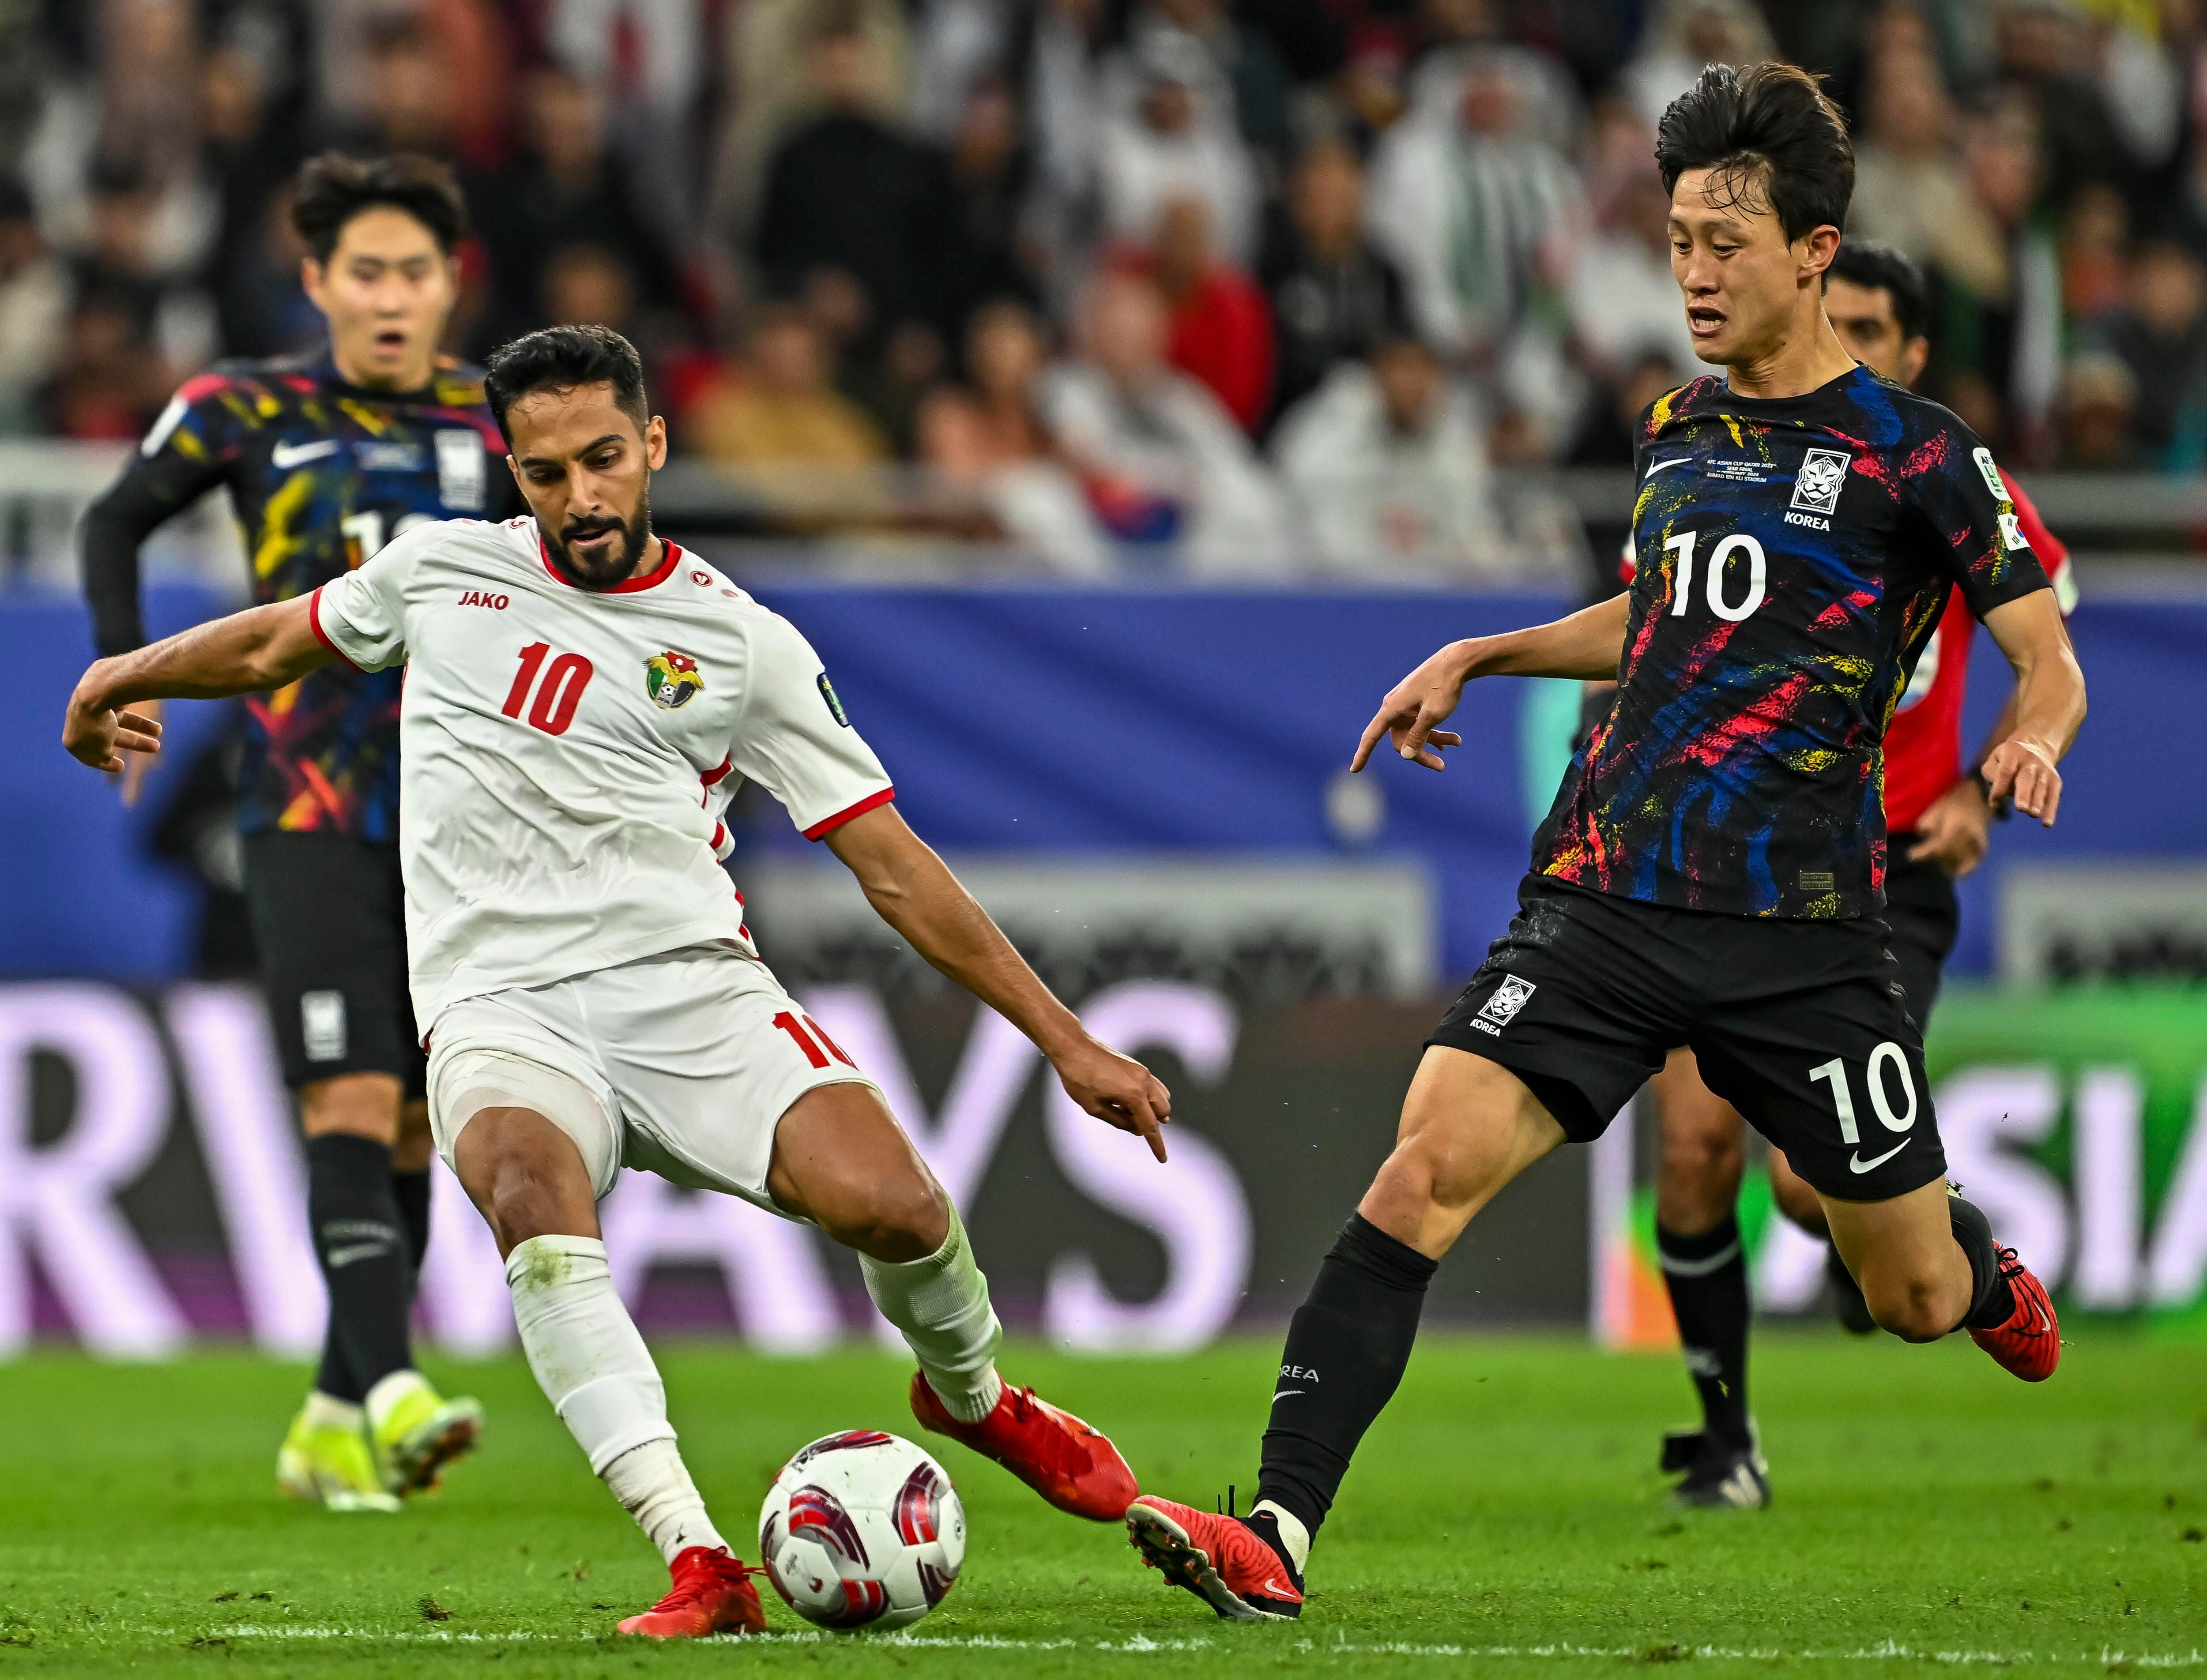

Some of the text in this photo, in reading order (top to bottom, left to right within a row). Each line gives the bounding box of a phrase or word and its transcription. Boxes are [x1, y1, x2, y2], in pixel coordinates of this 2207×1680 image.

[1784, 511, 1830, 532] KOREA
[1663, 531, 1766, 621] 10
[457, 591, 509, 610] JAKO
[501, 641, 594, 736] 10
[1469, 1019, 1501, 1037] KOREA
[1809, 1041, 1917, 1144] 10
[1278, 1365, 1319, 1383] REA
